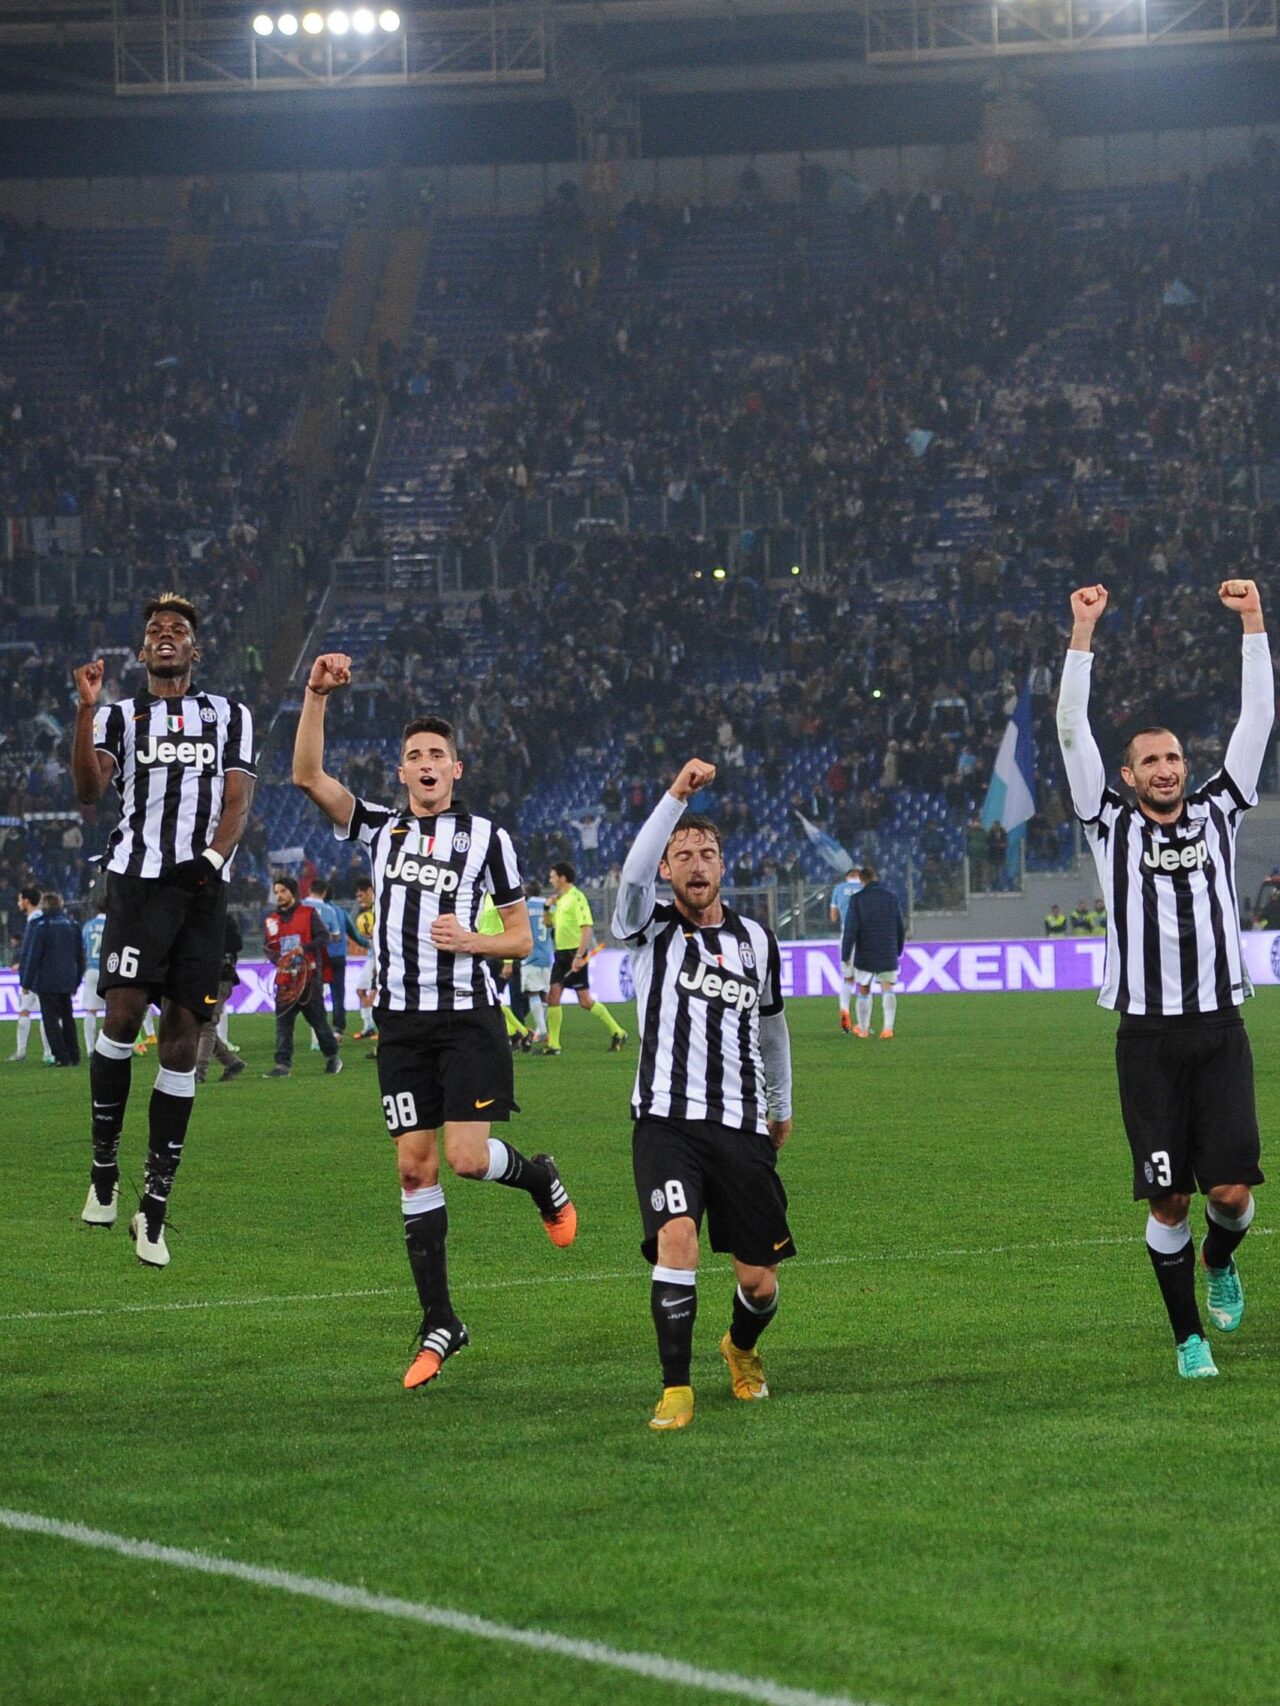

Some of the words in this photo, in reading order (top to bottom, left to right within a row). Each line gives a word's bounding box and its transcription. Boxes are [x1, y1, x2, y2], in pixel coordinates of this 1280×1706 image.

[137, 737, 216, 770] Jeep
[385, 852, 460, 894] Jeep
[1144, 840, 1208, 871] Jeep
[119, 946, 140, 978] 6
[806, 944, 1056, 995] NXEN
[679, 962, 757, 1013] Jeep
[383, 1091, 418, 1130] 38
[1151, 1150, 1172, 1187] 3
[664, 1179, 688, 1214] 8
